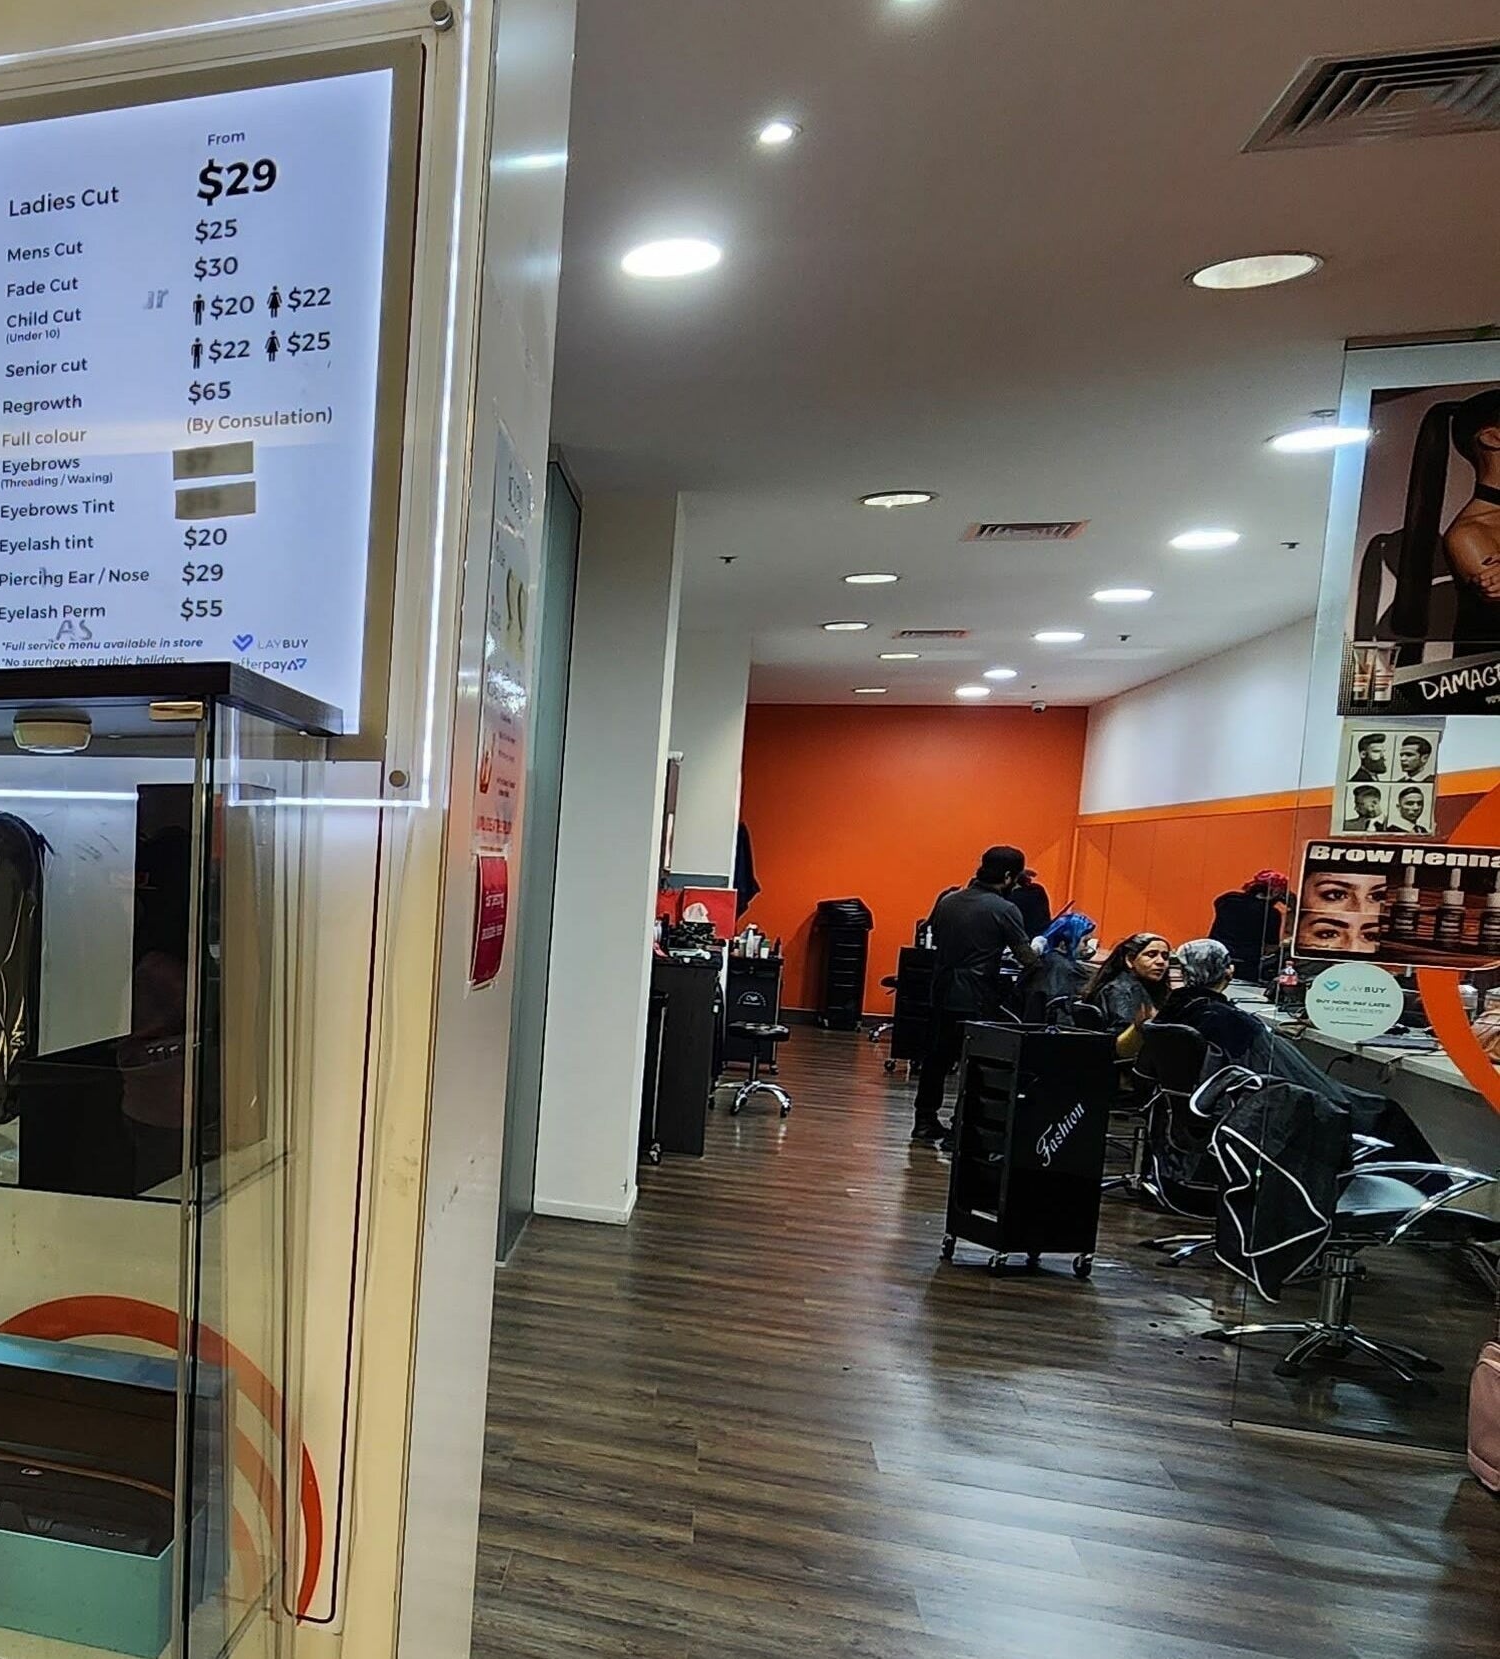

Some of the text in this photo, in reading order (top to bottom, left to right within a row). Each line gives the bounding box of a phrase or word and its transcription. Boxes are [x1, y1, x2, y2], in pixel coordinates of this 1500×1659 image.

[207, 131, 245, 146] From
[9, 158, 277, 217] Ladies Cut $29
[7, 219, 238, 263] Mens Cut $25
[6, 256, 239, 298] Fade Cut $30
[6, 287, 332, 329] Child Cut $20 $22
[5, 328, 61, 344] (Under 10)
[5, 331, 331, 378] Senior cut $22 $25
[3, 381, 231, 416] Regrowth $65
[2, 407, 333, 447] Full colour (By Consulation)
[1, 456, 80, 474] Eyebrows
[0, 472, 113, 490] (Threading / Waxing)
[0, 503, 79, 521] Eyebrows
[83, 499, 115, 515] Tint
[0, 526, 228, 554] Eyelash tint $20
[68, 570, 95, 586] Ear
[97, 568, 106, 585] /
[109, 568, 150, 584] Nose
[182, 562, 224, 586] $29
[63, 603, 106, 620] Perm
[180, 598, 223, 622] $55
[28, 640, 66, 650] service
[68, 642, 100, 650] menu
[103, 638, 156, 649] available
[159, 638, 170, 648] in
[172, 637, 203, 648] store
[258, 639, 308, 649] LAYBUY
[22, 656, 77, 667] surcharge
[80, 658, 96, 666] on
[99, 655, 132, 665] public
[136, 654, 185, 664] holidays
[239, 657, 287, 673] fterpay
[1309, 845, 1394, 863] Brow
[1036, 1102, 1085, 1167] Fashion
